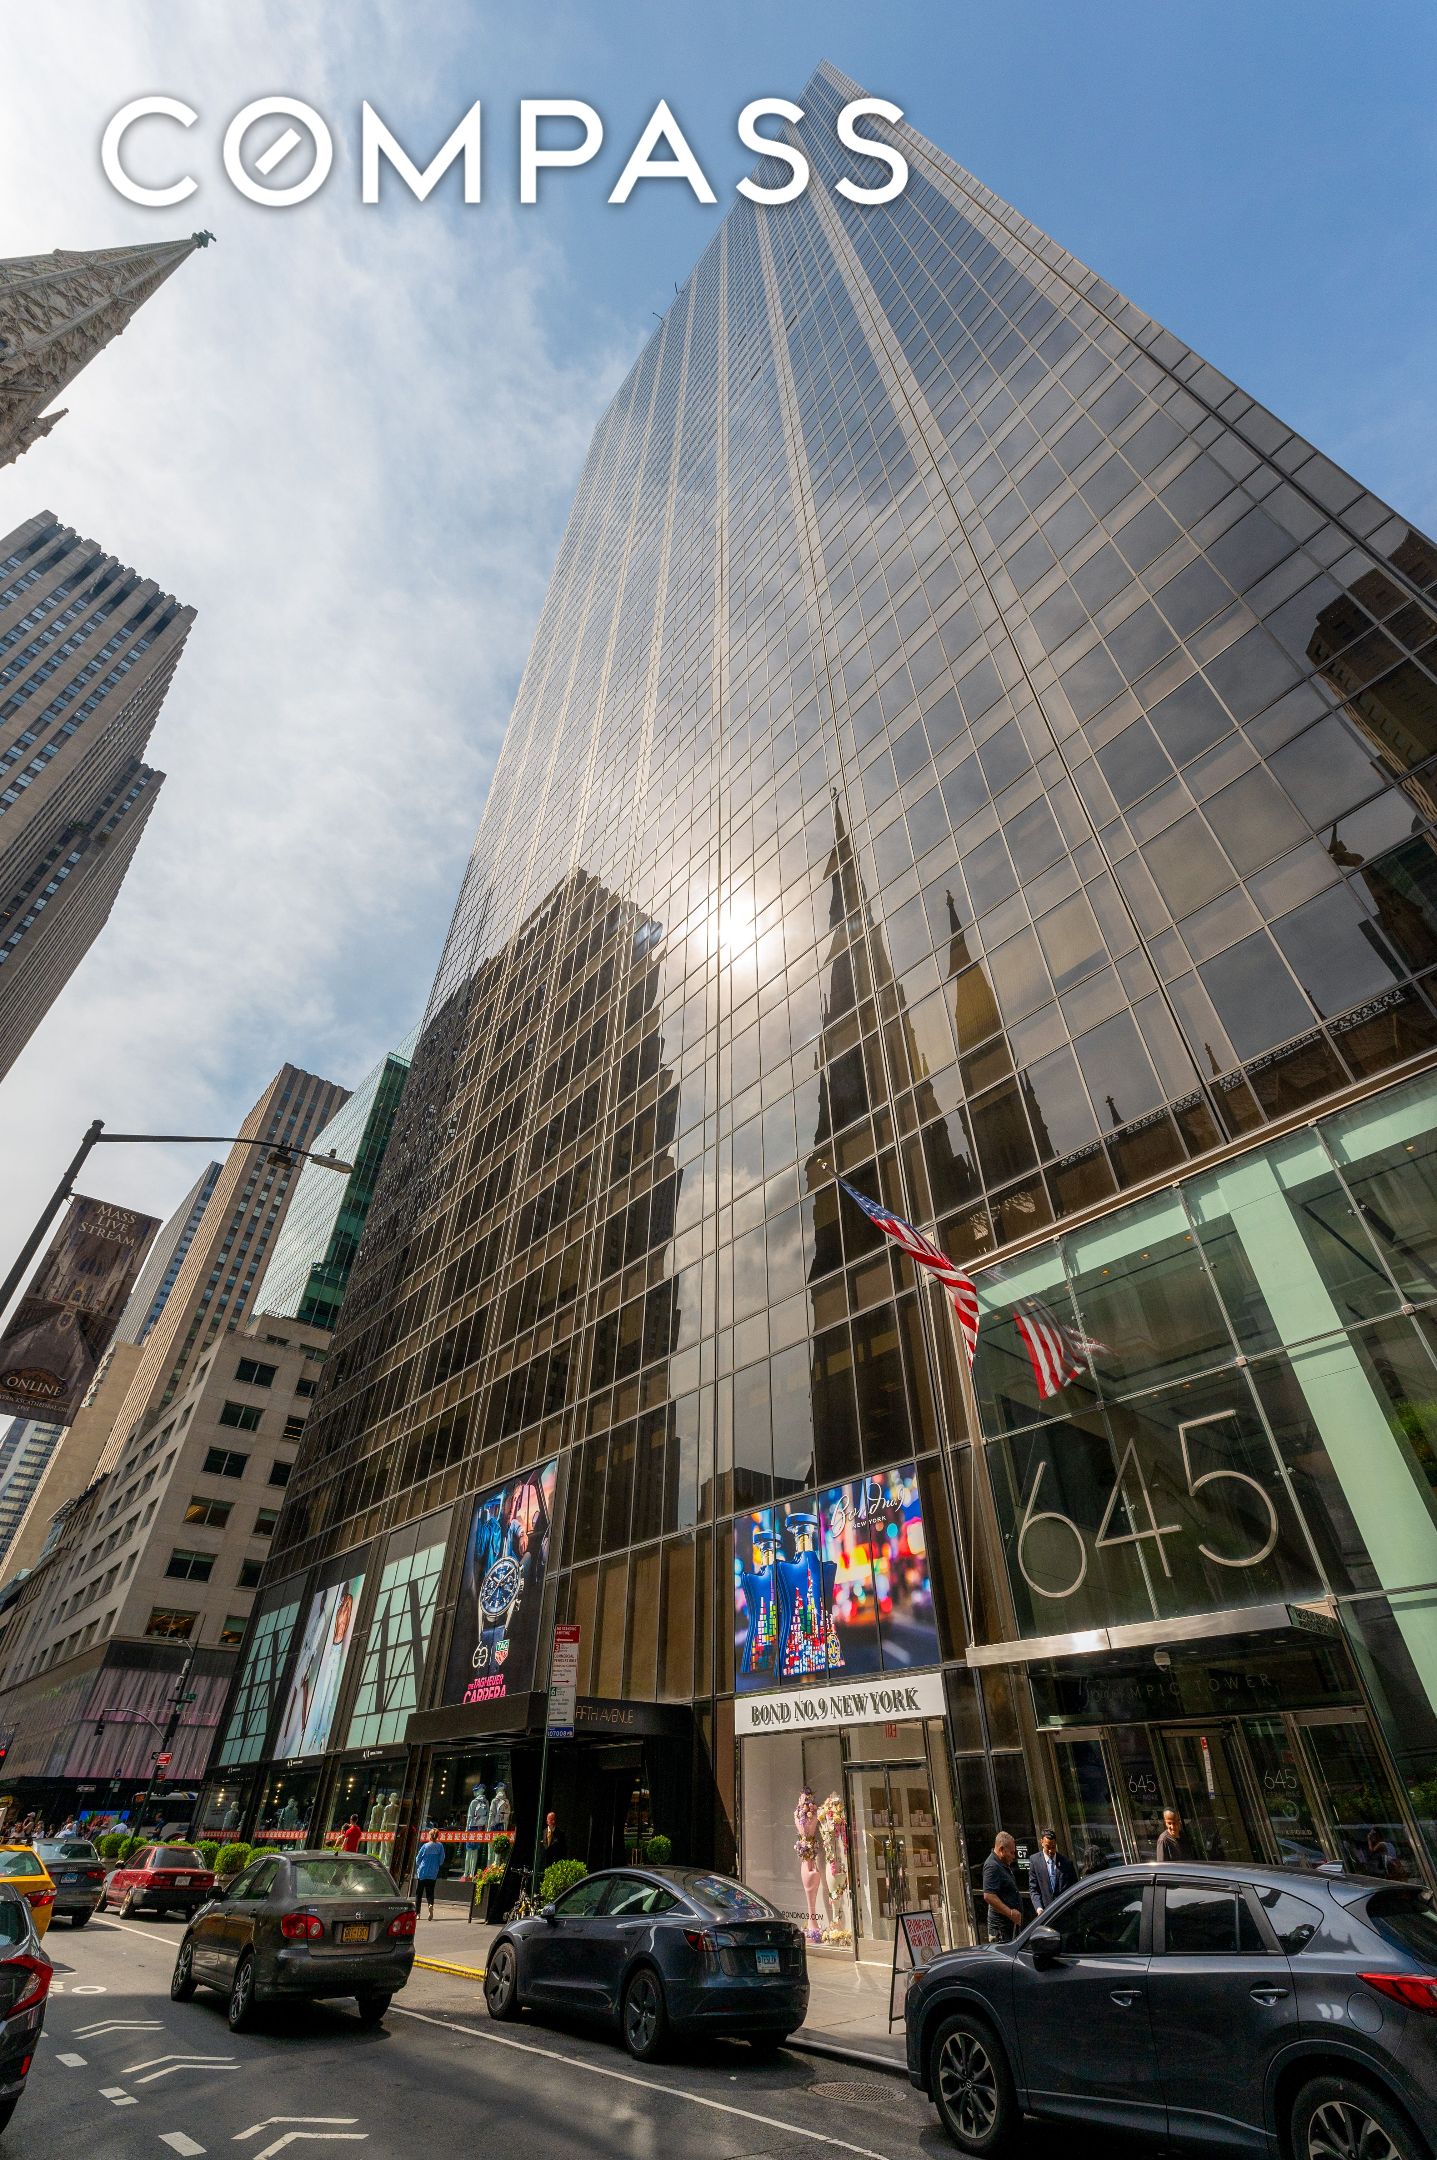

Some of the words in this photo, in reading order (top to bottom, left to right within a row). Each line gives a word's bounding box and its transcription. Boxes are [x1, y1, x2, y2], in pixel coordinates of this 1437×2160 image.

[97, 1204, 137, 1224] MASS
[78, 1221, 135, 1247] STREAM
[97, 1216, 129, 1233] LIVE
[6, 1376, 63, 1396] ONLINE
[1018, 1409, 1278, 1598] 645
[853, 1520, 867, 1529] NEW
[868, 1515, 887, 1525] YORK
[497, 1640, 509, 1650] TAG
[551, 1687, 556, 1696] 6
[751, 1702, 792, 1727] BOND
[830, 1693, 869, 1719] NEW
[868, 1687, 921, 1714] YORK
[1128, 1774, 1157, 1793] 645
[1264, 1768, 1298, 1790] 645
